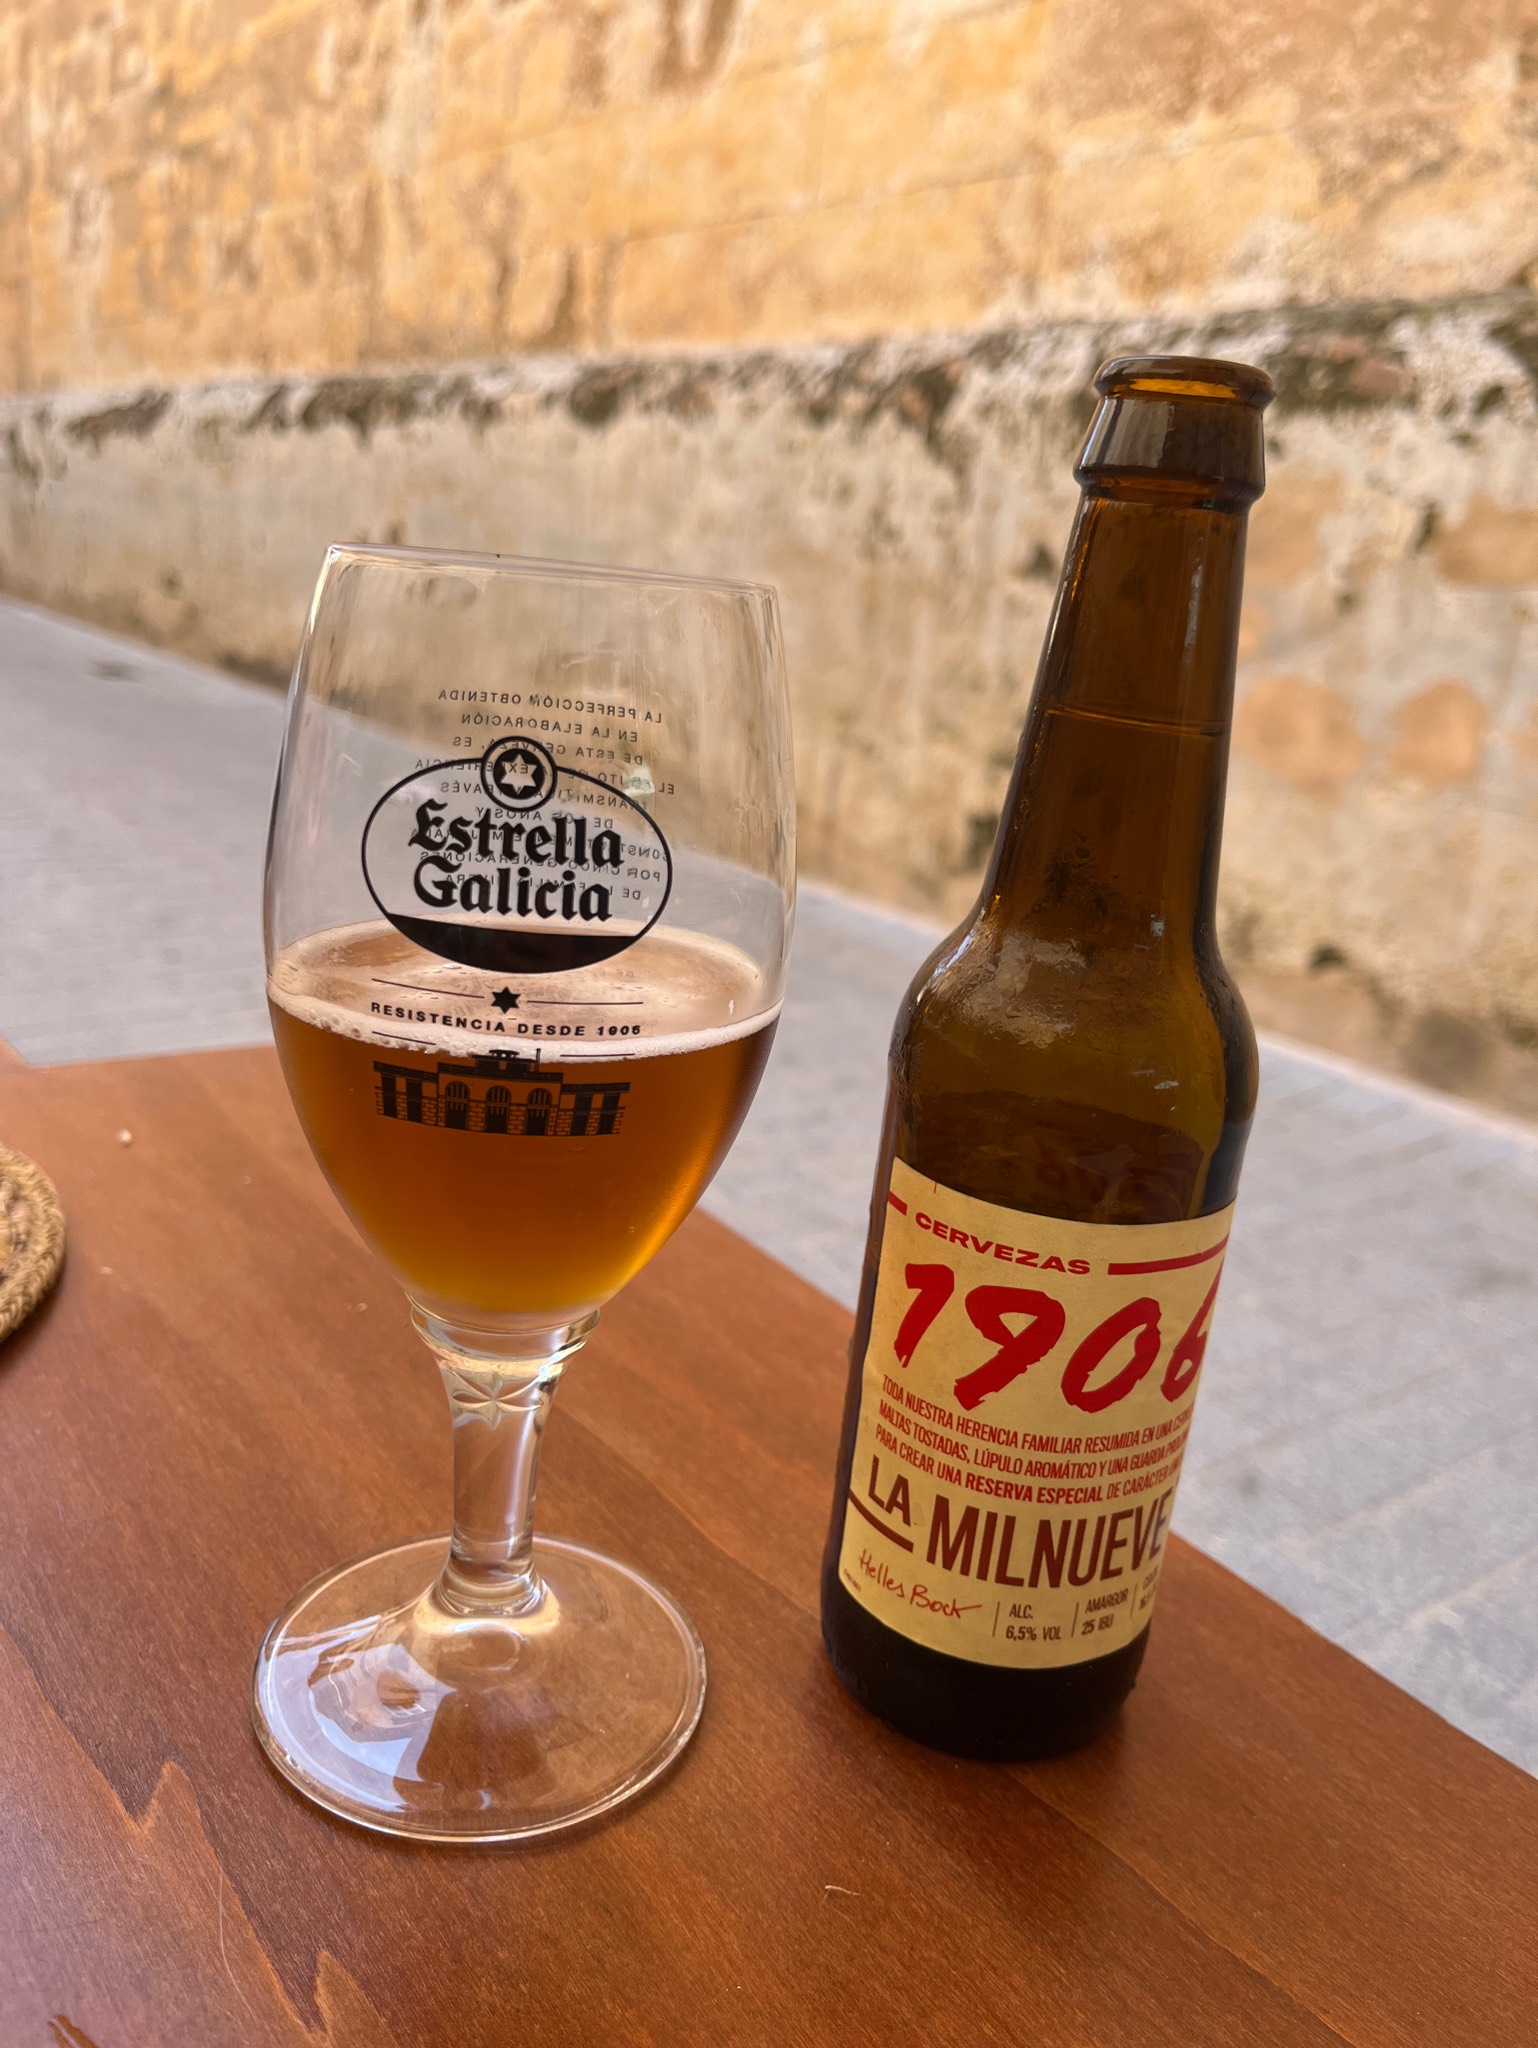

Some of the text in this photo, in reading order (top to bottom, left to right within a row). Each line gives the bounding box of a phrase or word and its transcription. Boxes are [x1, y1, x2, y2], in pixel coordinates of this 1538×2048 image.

[408, 798, 624, 868] Estrella
[413, 855, 613, 922] Galicia
[371, 1001, 641, 1036] RESISTENCIA DESDE 1906
[915, 1211, 1091, 1275] CERVEZAS
[893, 1257, 1224, 1413] 1906
[879, 1399, 911, 1436] MALTAS
[913, 1421, 971, 1464] TOSTADAS,
[973, 1447, 1023, 1475] LÚPULO
[1024, 1459, 1097, 1480] AROMÁTICO
[1099, 1460, 1108, 1478] Y
[1108, 1456, 1128, 1476] UNA
[1130, 1445, 1167, 1471] GUARDA
[882, 1374, 904, 1404] TODA
[905, 1391, 953, 1430] NUESTRA
[955, 1415, 1019, 1448] HERENCIA
[1021, 1432, 1083, 1454] FAMILIAR
[1084, 1429, 1140, 1454] RESUMIDA
[1141, 1426, 1155, 1445] EN
[1155, 1418, 1173, 1440] UNA
[875, 1423, 897, 1455] PARA
[899, 1441, 935, 1475] CREAR
[936, 1461, 962, 1487] UNA
[964, 1471, 1033, 1503] RESERVA
[1036, 1486, 1103, 1505] ESPECIAL
[1106, 1480, 1121, 1500] DE
[868, 1454, 1174, 1589] LA MILNUEVE
[859, 1548, 905, 1598] Helles
[909, 1583, 983, 1620] Bock
[1008, 1603, 1034, 1620] ALC.
[1005, 1625, 1062, 1641] 6,5% VOL
[1080, 1619, 1096, 1636] 25
